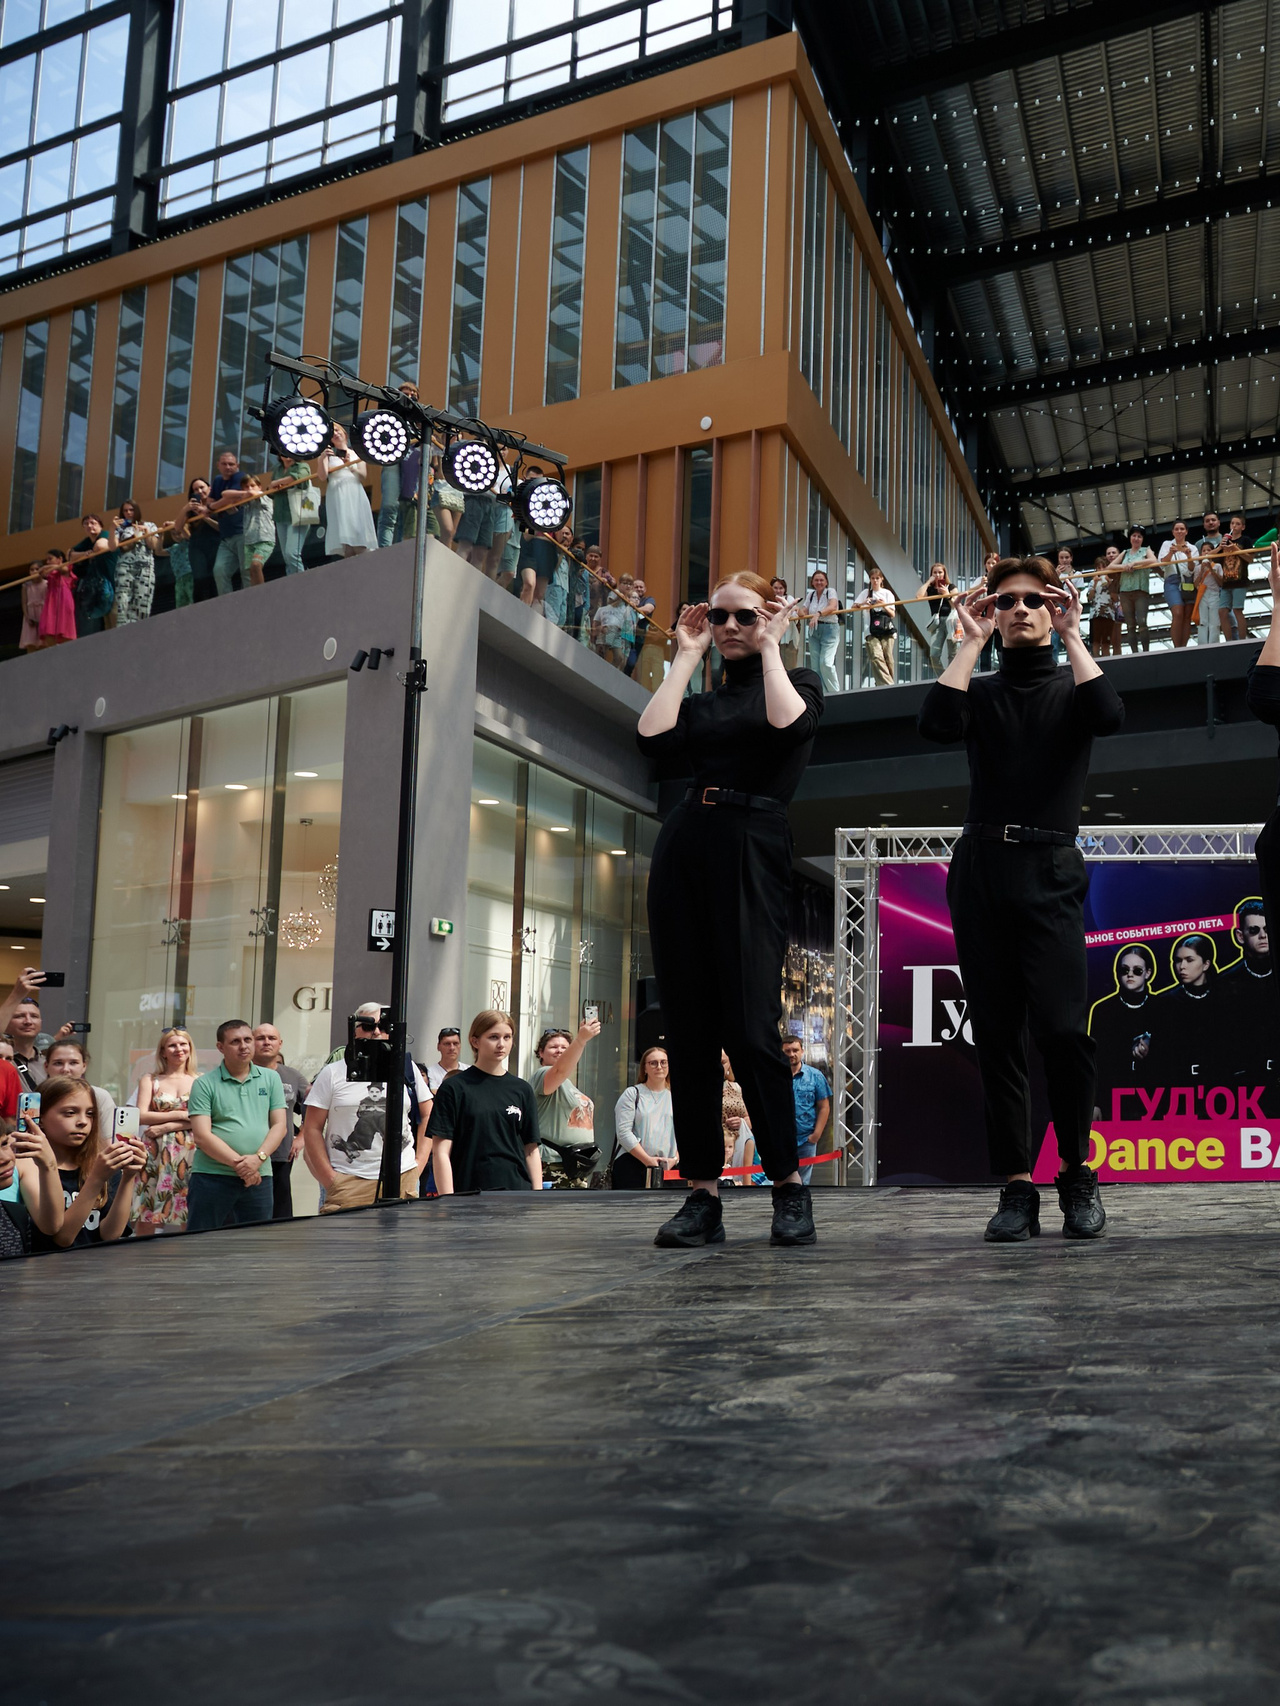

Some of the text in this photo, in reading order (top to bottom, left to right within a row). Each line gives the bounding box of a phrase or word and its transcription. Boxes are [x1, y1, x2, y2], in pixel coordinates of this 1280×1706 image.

[1116, 924, 1163, 941] СОБЫТИЕ
[1165, 921, 1196, 934] ЭТОГО
[1198, 918, 1224, 930] ЛЕТА
[1086, 1128, 1226, 1171] Dance
